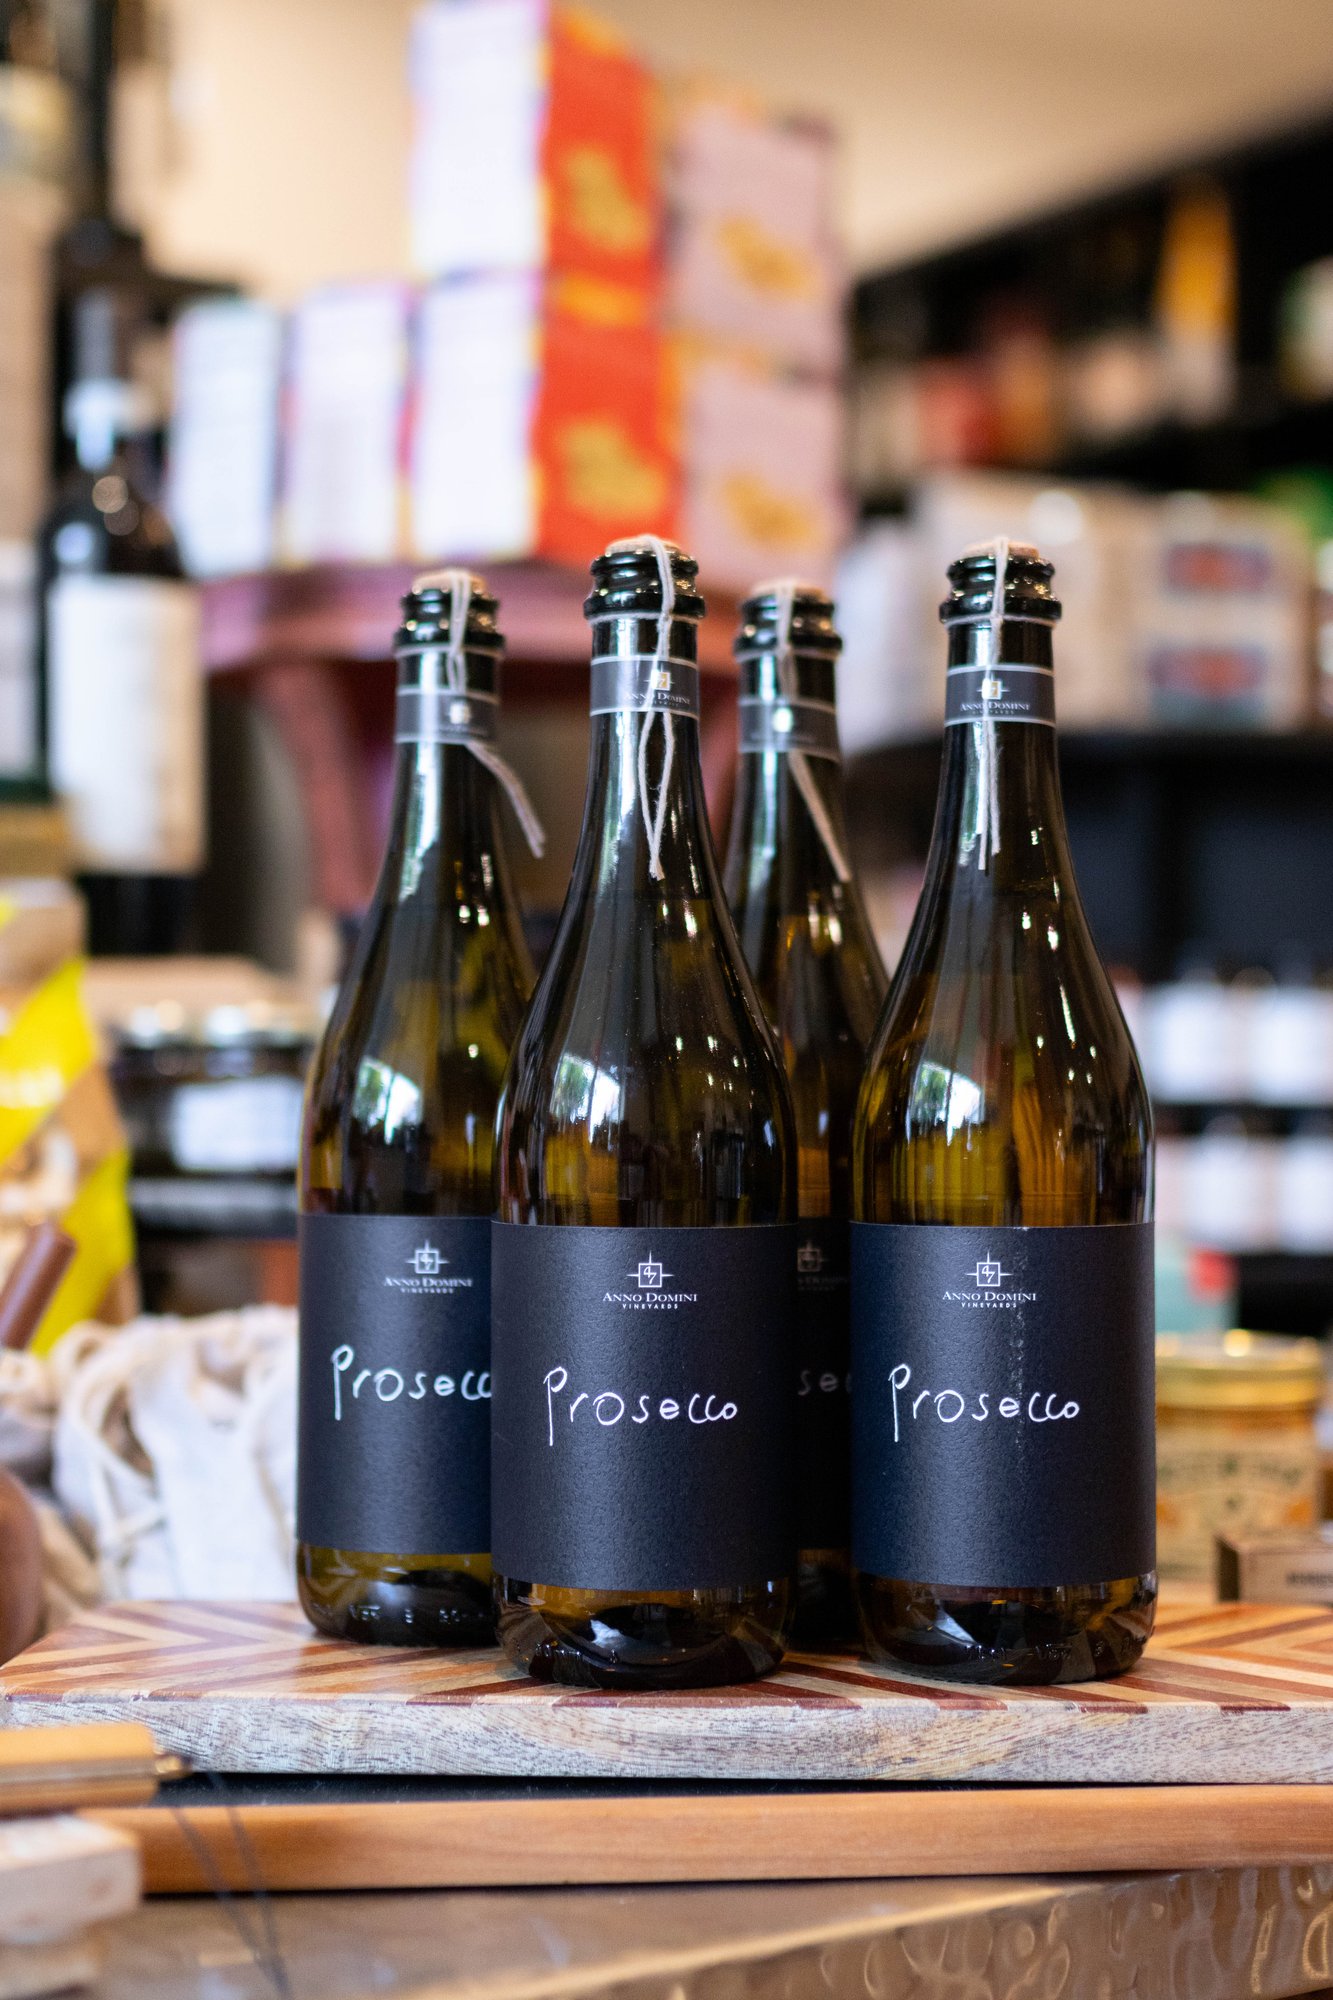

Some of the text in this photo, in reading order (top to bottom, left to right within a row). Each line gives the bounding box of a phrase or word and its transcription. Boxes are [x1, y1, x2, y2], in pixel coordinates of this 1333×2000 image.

[988, 701, 1031, 711] DOMINI
[384, 1278, 473, 1287] ANNO DOMINI
[643, 1266, 657, 1285] 47
[981, 1265, 996, 1284] 47
[602, 1292, 698, 1302] ANNO DOMINI
[942, 1291, 1036, 1301] ANNO DOMINI
[331, 1344, 492, 1421] Prosecc
[543, 1366, 738, 1447] Prosecco
[888, 1363, 1080, 1443] Prosecco
